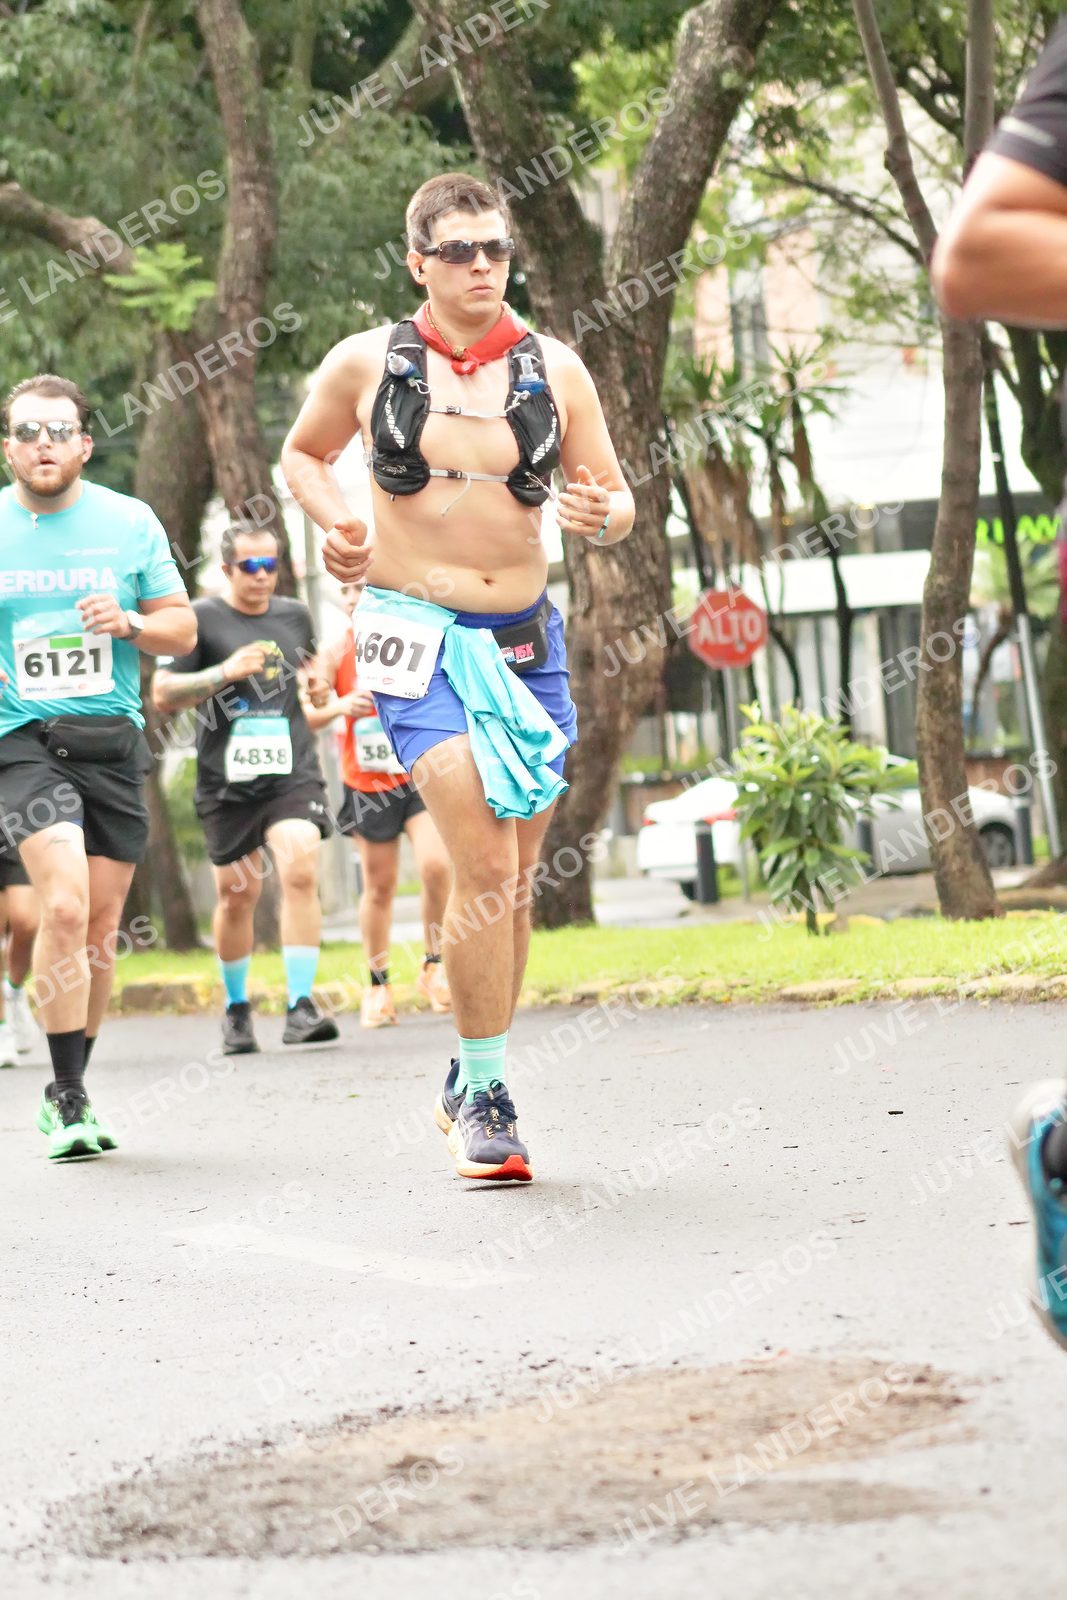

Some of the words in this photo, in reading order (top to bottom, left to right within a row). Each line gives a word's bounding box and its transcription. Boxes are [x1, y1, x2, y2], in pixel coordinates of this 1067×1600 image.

[0, 566, 118, 593] ERDURA
[698, 609, 762, 646] ALTO
[25, 648, 101, 677] 6121
[356, 632, 426, 672] 4601
[234, 748, 287, 765] 4838
[362, 744, 393, 761] 38
